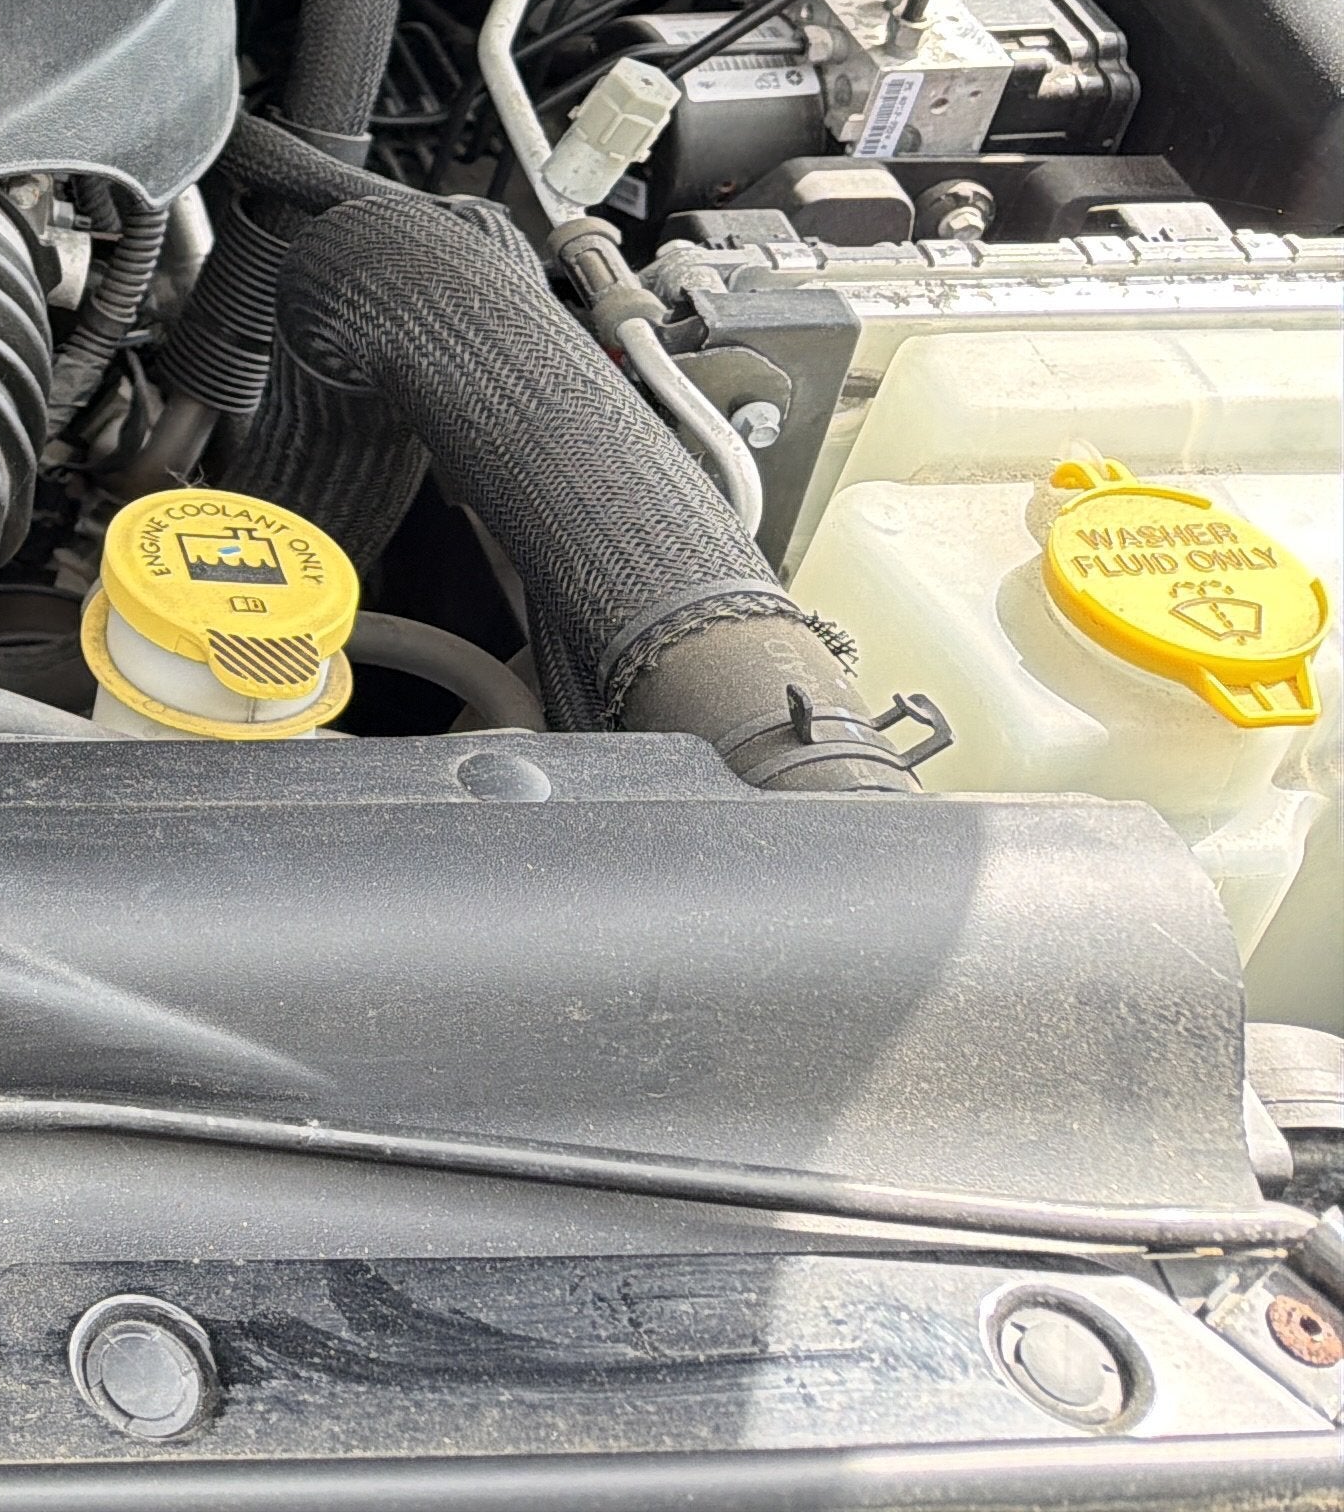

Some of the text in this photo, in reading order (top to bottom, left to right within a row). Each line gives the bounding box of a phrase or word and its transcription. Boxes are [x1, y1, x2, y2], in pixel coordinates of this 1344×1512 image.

[139, 502, 324, 584] ENGINE COOLANT ONLY
[1076, 522, 1238, 550] WASHER
[1072, 546, 1280, 578] FLUID ONLY
